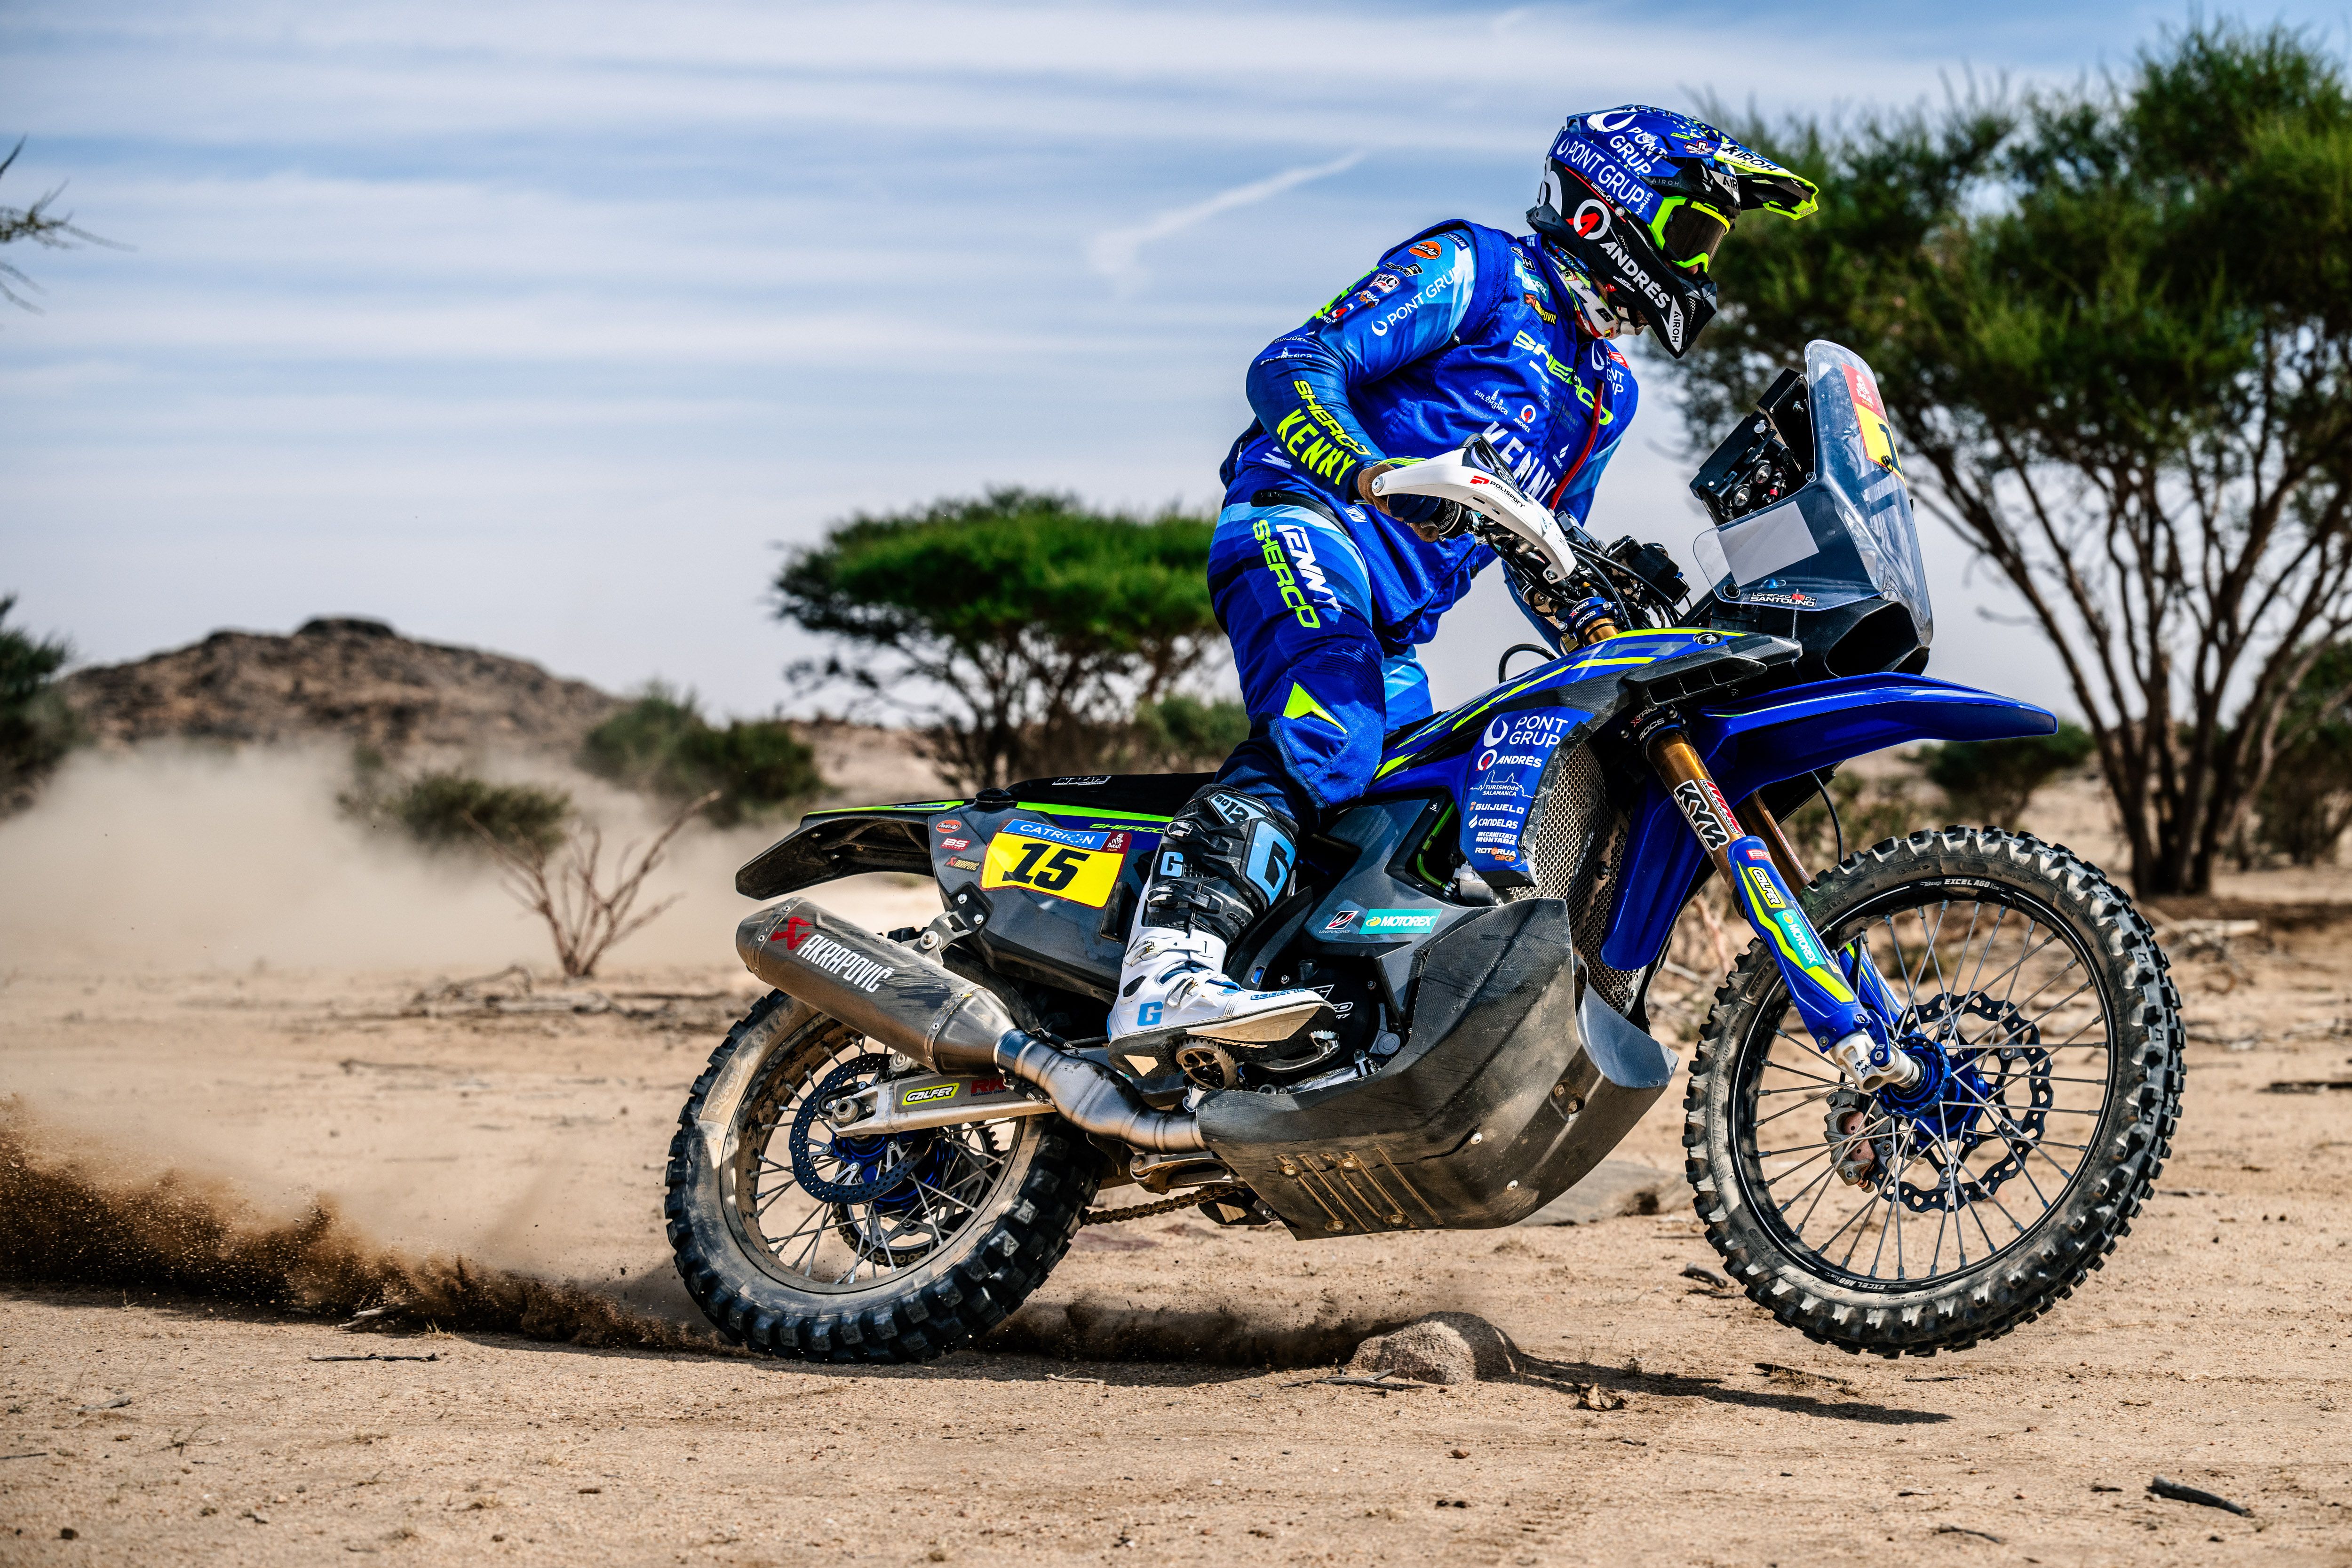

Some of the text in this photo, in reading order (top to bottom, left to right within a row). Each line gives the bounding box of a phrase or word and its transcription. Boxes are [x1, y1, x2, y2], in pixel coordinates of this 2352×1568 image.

[1610, 135, 1652, 174] GRUP
[1626, 127, 1668, 164] PONT
[1720, 145, 1779, 171] AIROH
[1565, 140, 1645, 205] PONT GRUP
[1591, 183, 1606, 198] SANTOLINO
[1651, 177, 1680, 187] AIROH
[1599, 241, 1670, 309] ANDRÉS
[1387, 293, 1428, 326] PONT
[1426, 265, 1462, 299] GRUP
[1672, 310, 1682, 342] AIROH
[1513, 330, 1613, 426] SHERCO
[1294, 380, 1372, 455] SHERCO
[1513, 417, 1531, 433] ANDRÉS
[1276, 408, 1357, 486] KENNY
[1253, 519, 1320, 629] SHERCO
[1276, 525, 1342, 612] KENNY
[1569, 601, 1589, 619] XTRIG
[1750, 596, 1815, 606] SANTOLINO
[1576, 610, 1596, 629] ROCS
[1515, 716, 1568, 733] PONT
[1509, 731, 1561, 748] GRUP
[1496, 755, 1543, 768] ANDRÉS
[1223, 801, 1249, 822] 12
[1475, 804, 1525, 815] GUIJUELO
[1675, 780, 1729, 850] KYB
[1701, 780, 1738, 834] RACING SUSPENSION
[1089, 823, 1165, 834] SHERCO
[1478, 819, 1518, 829] CANDELAS
[943, 838, 968, 848] BS
[1476, 836, 1516, 845] MUNTADA
[1478, 831, 1518, 840] MECANITZATS
[1475, 847, 1516, 857] ROTORUA
[1494, 854, 1516, 862] BIKE
[1002, 843, 1090, 891] 15
[1752, 869, 1781, 905] GALFER
[1381, 916, 1435, 927] MOTOREX
[1788, 923, 1819, 964] MOTOREX
[1251, 988, 1306, 1001] GAERNE
[1137, 1002, 1164, 1026] G
[907, 1086, 954, 1101] GALFER
[971, 1078, 1006, 1094] RK
[1713, 1069, 1728, 1151] MICHELIN
[1839, 1278, 1856, 1286] A60
[1857, 1282, 1886, 1290] EXCEL
